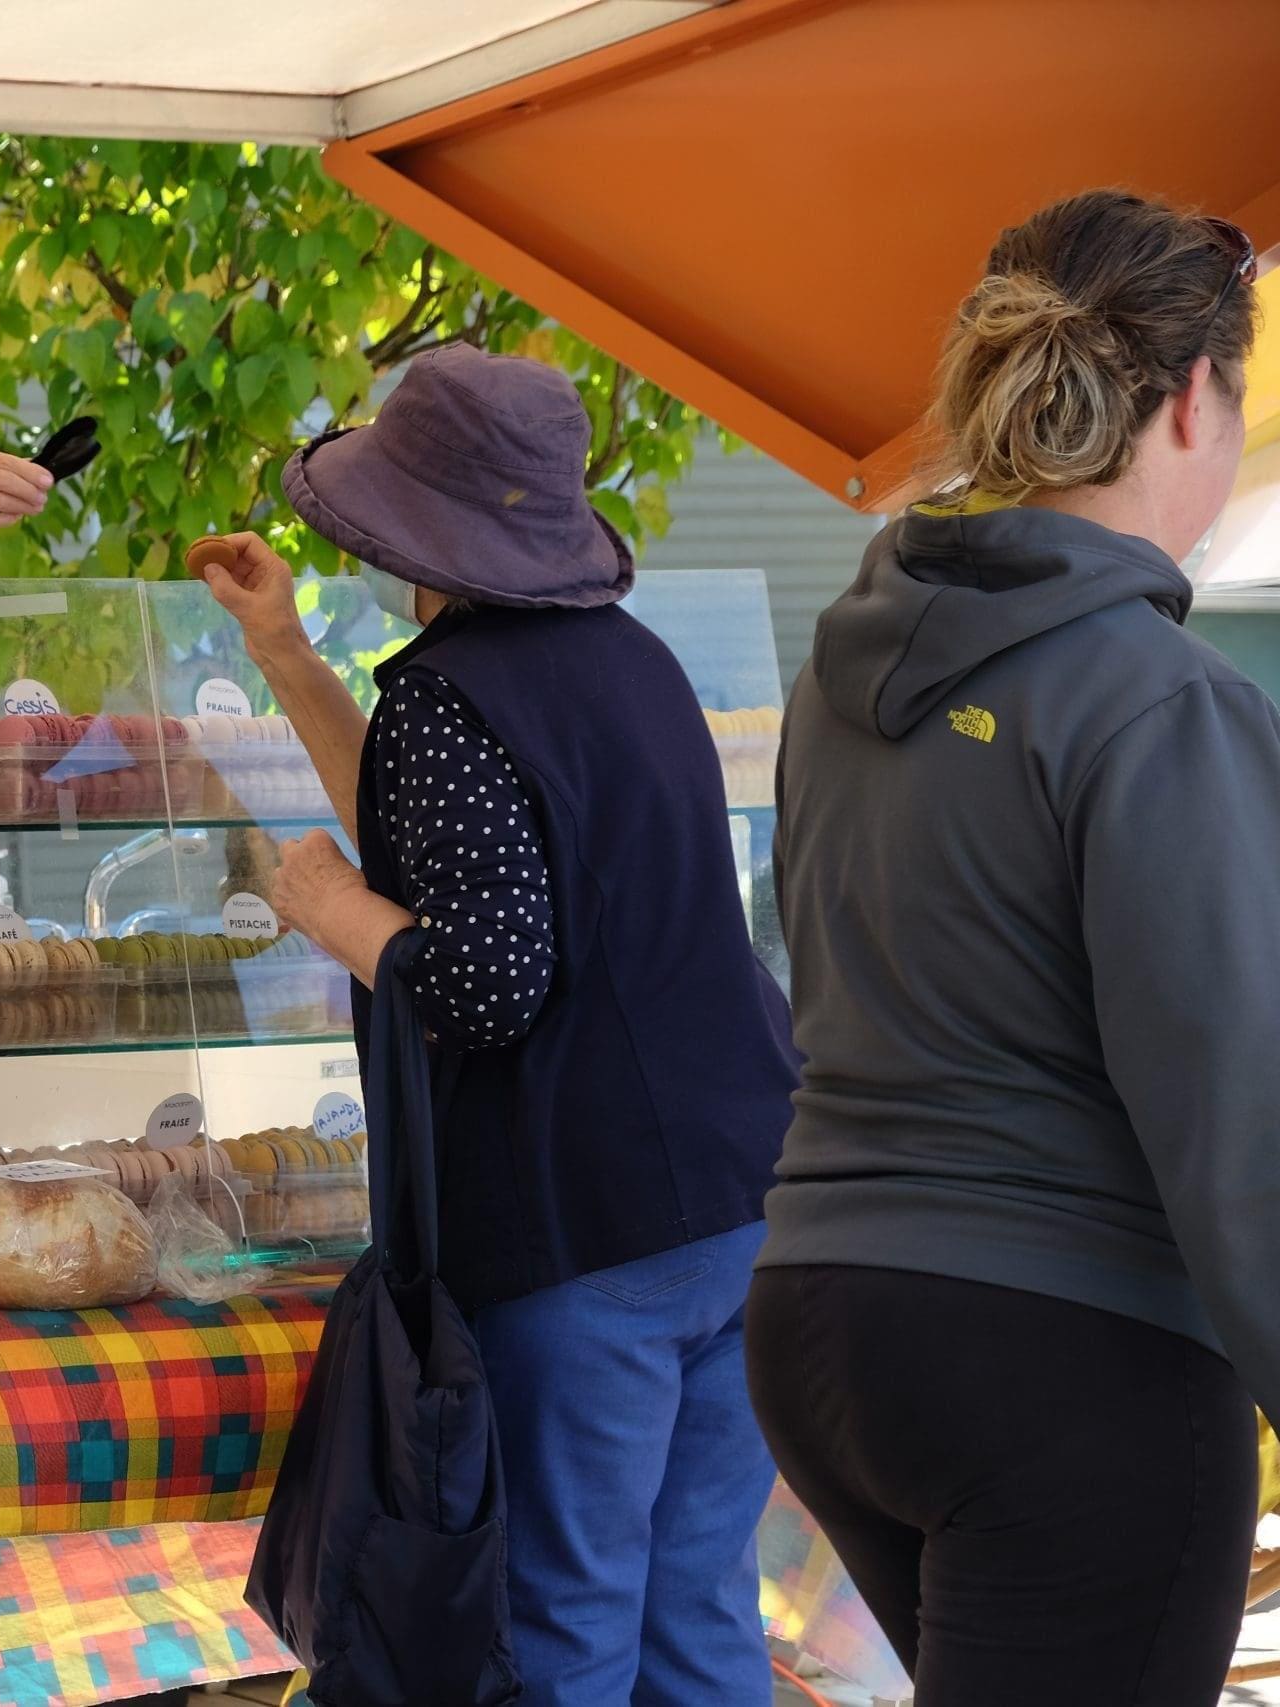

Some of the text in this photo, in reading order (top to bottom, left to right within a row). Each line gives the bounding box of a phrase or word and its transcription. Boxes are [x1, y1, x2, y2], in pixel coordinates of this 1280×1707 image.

[206, 702, 242, 716] PRALINE
[965, 704, 983, 719] THE
[947, 709, 980, 729] NORTH
[951, 721, 976, 738] FACE
[229, 919, 272, 930] PISTACHE
[159, 1117, 191, 1130] FRAISE
